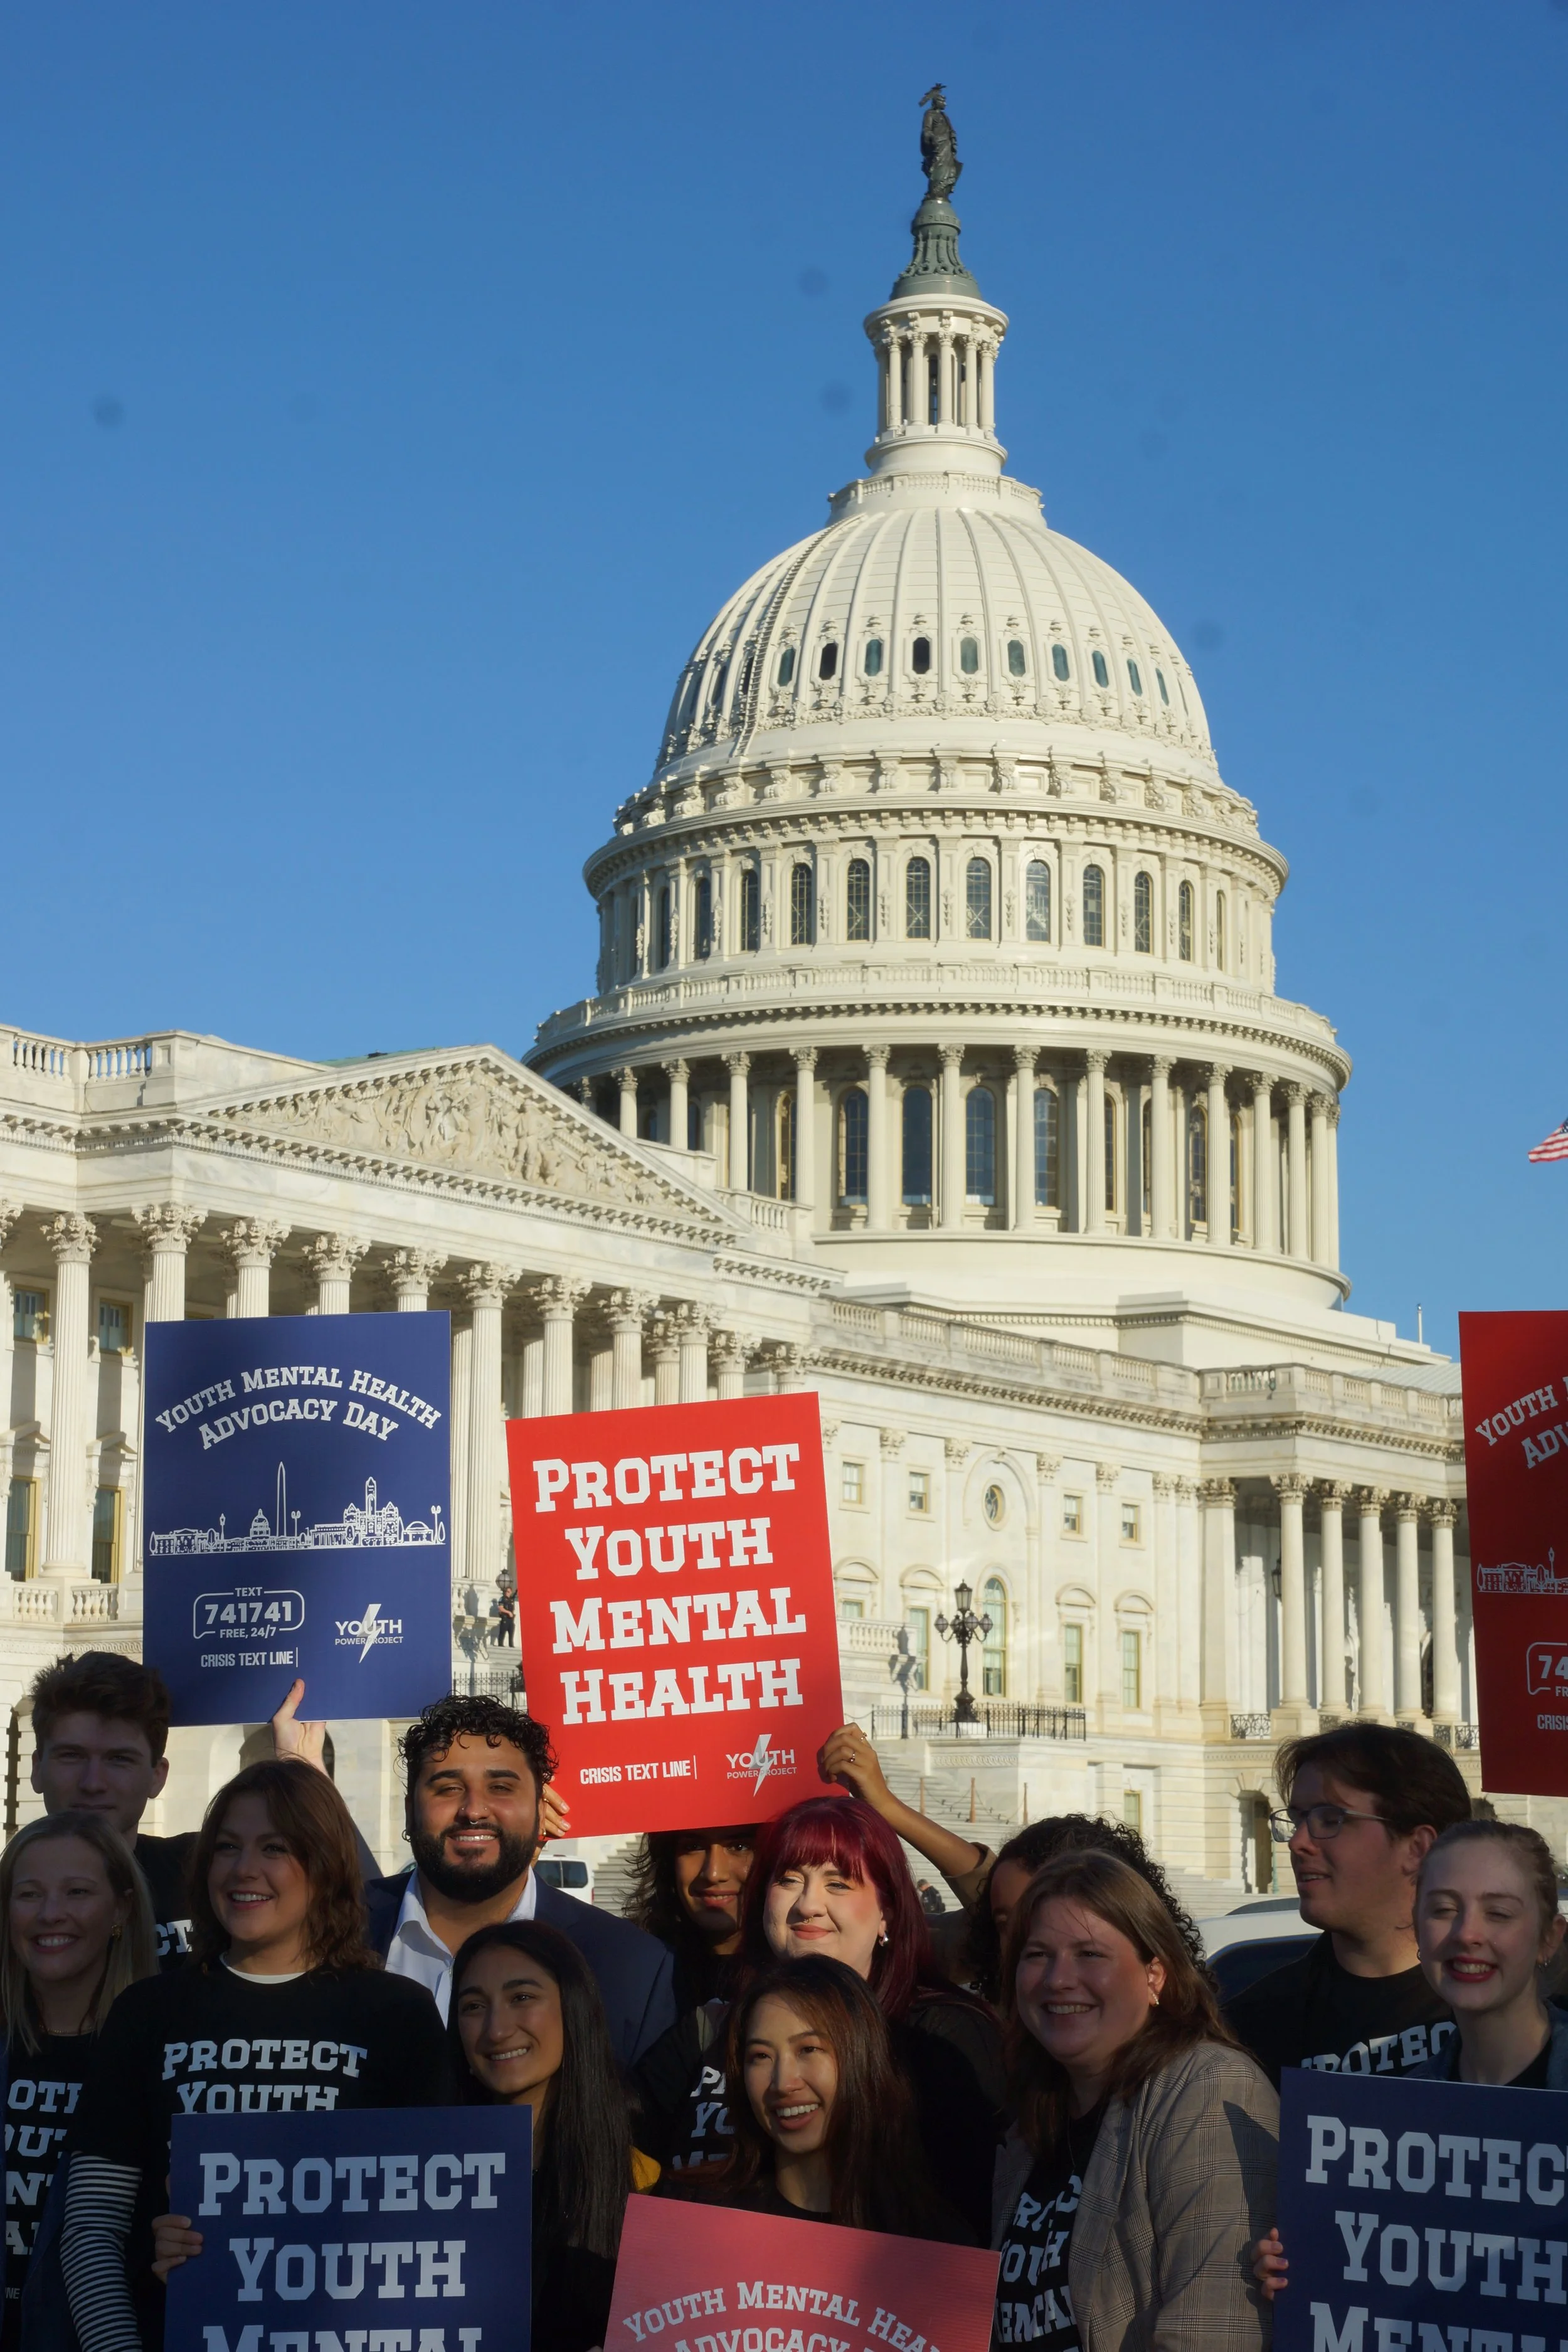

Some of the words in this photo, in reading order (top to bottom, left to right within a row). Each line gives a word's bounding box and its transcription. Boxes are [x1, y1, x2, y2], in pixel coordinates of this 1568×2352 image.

[156, 1379, 236, 1433] YOUTH
[241, 1366, 342, 1393] MENTAL
[349, 1370, 442, 1429] HEALTH
[198, 1398, 338, 1450] ADVOCACY
[342, 1401, 399, 1441] DAY
[1475, 1384, 1559, 1446] YOUTH
[532, 1443, 800, 1513] PROTECT
[564, 1517, 773, 1581] YOUTH
[204, 1601, 292, 1624] 741741
[235, 1586, 263, 1597] TEXT
[220, 1628, 249, 1640] FREE,
[250, 1624, 277, 1639] 24/7
[335, 1619, 402, 1635] YOUTH
[335, 1637, 366, 1645] POWER
[549, 1587, 807, 1654] MENTAL
[201, 1653, 236, 1668] CRISIS
[238, 1651, 267, 1666] TEXT
[270, 1650, 294, 1665] LINE
[559, 1658, 803, 1725] HEALTH
[580, 1766, 622, 1785] CRISIS
[625, 1762, 659, 1781] TEXT
[662, 1760, 691, 1778] LINE
[726, 1749, 795, 1769] YOUTH
[726, 1769, 759, 1779] POWER
[162, 2038, 368, 2080] PROTECT
[176, 2081, 339, 2114] YOUTH
[198, 2152, 506, 2216] PROTECT
[1305, 2114, 1568, 2206] PROTEC
[229, 2237, 466, 2302] YOUTH
[1335, 2210, 1568, 2305] YOUTH
[622, 2287, 727, 2342] YOUTH
[736, 2280, 860, 2326] MENTAL
